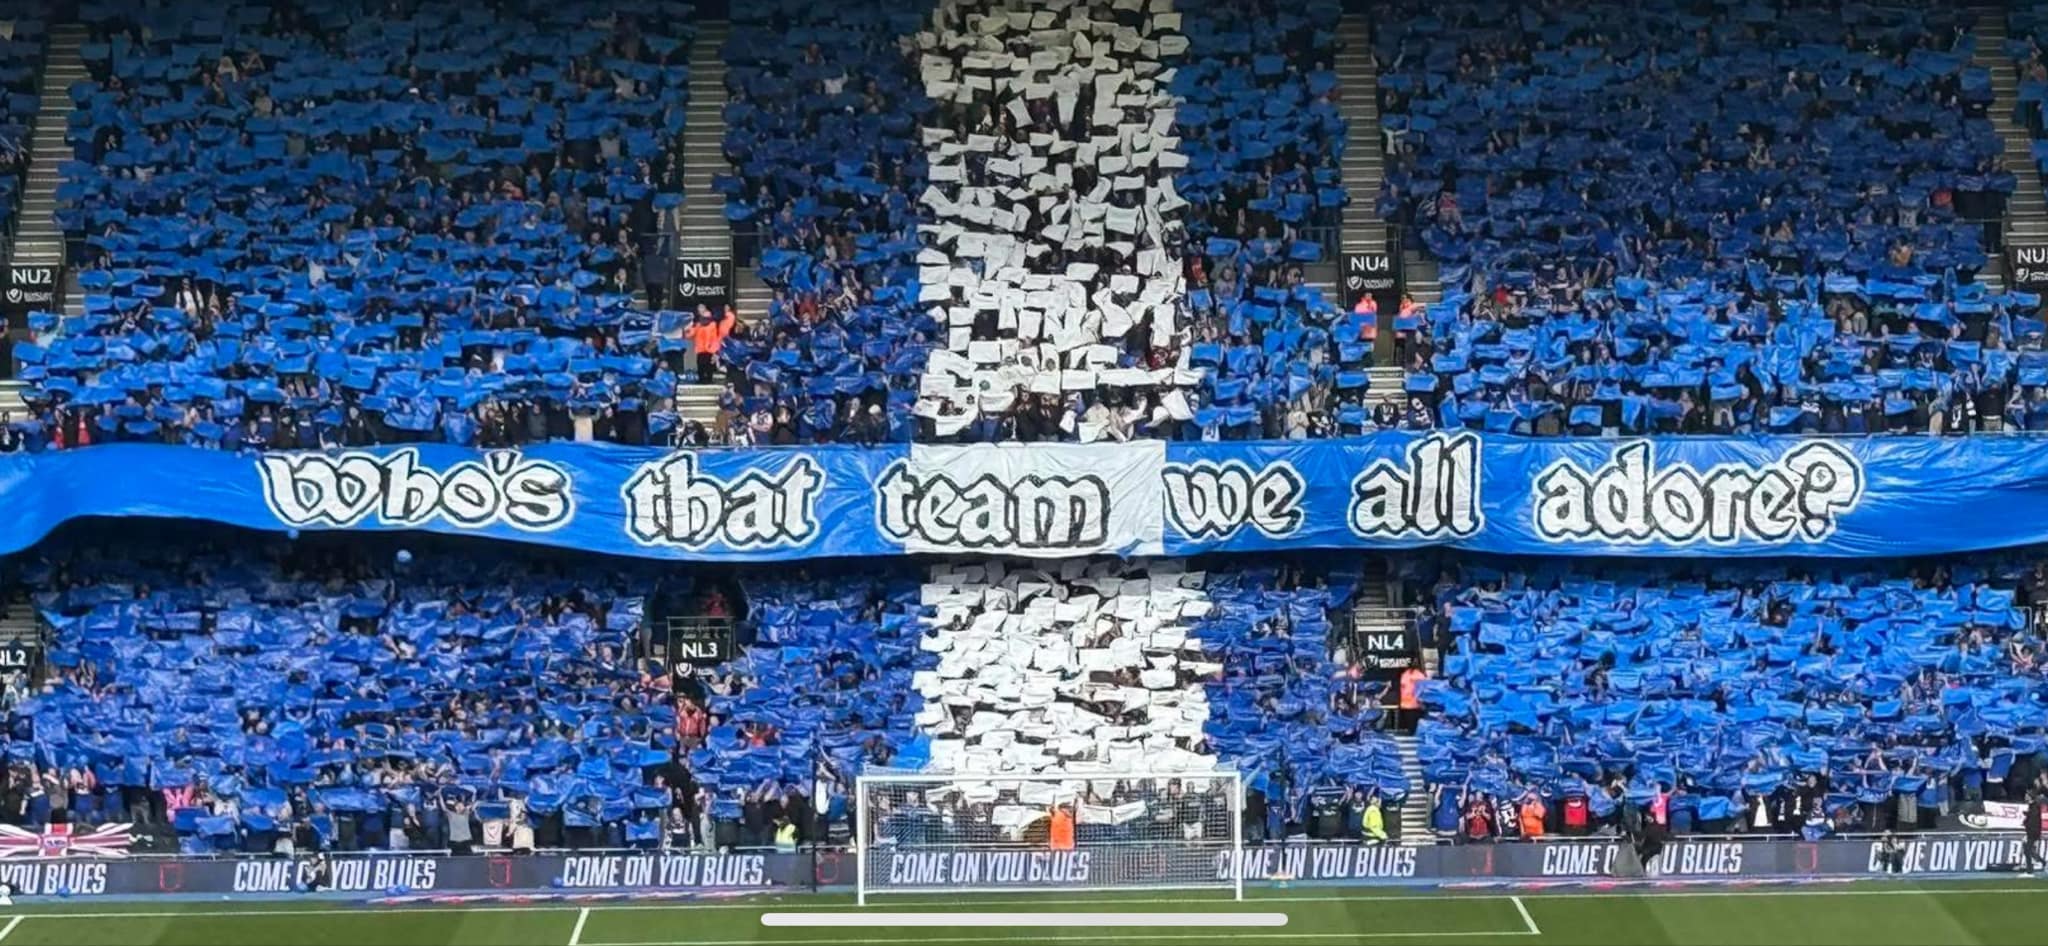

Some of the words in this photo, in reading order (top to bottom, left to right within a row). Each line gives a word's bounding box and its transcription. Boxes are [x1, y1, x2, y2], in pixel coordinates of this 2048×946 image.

[683, 262, 722, 278] NU3
[1350, 255, 1389, 271] NU4
[2017, 247, 2048, 264] NU
[12, 268, 52, 284] NU2
[258, 448, 575, 532] Who's
[622, 448, 826, 550] that
[875, 457, 1111, 548] team
[1162, 459, 1307, 540] we
[1347, 430, 1485, 541] all
[1532, 439, 1865, 546] adore?
[682, 642, 718, 658] NL3
[1367, 634, 1404, 650] NL4
[563, 856, 622, 887] COME
[623, 856, 654, 886] ON
[658, 855, 699, 886] YOU
[701, 854, 765, 886] BLUES
[890, 852, 949, 883] COME
[951, 852, 984, 883] ON
[985, 851, 1027, 882] YOU
[1029, 851, 1090, 881] BLUES
[1311, 847, 1352, 878] YOU
[1354, 847, 1417, 877] BLUES
[1542, 845, 1602, 875] COME
[1680, 843, 1743, 874] BLUES
[1929, 841, 1961, 872] ON
[1964, 840, 2004, 872] YOU
[43, 863, 107, 895] BLUES
[233, 860, 293, 892] COME
[330, 859, 370, 890] YOU
[373, 858, 436, 890] BLUES
